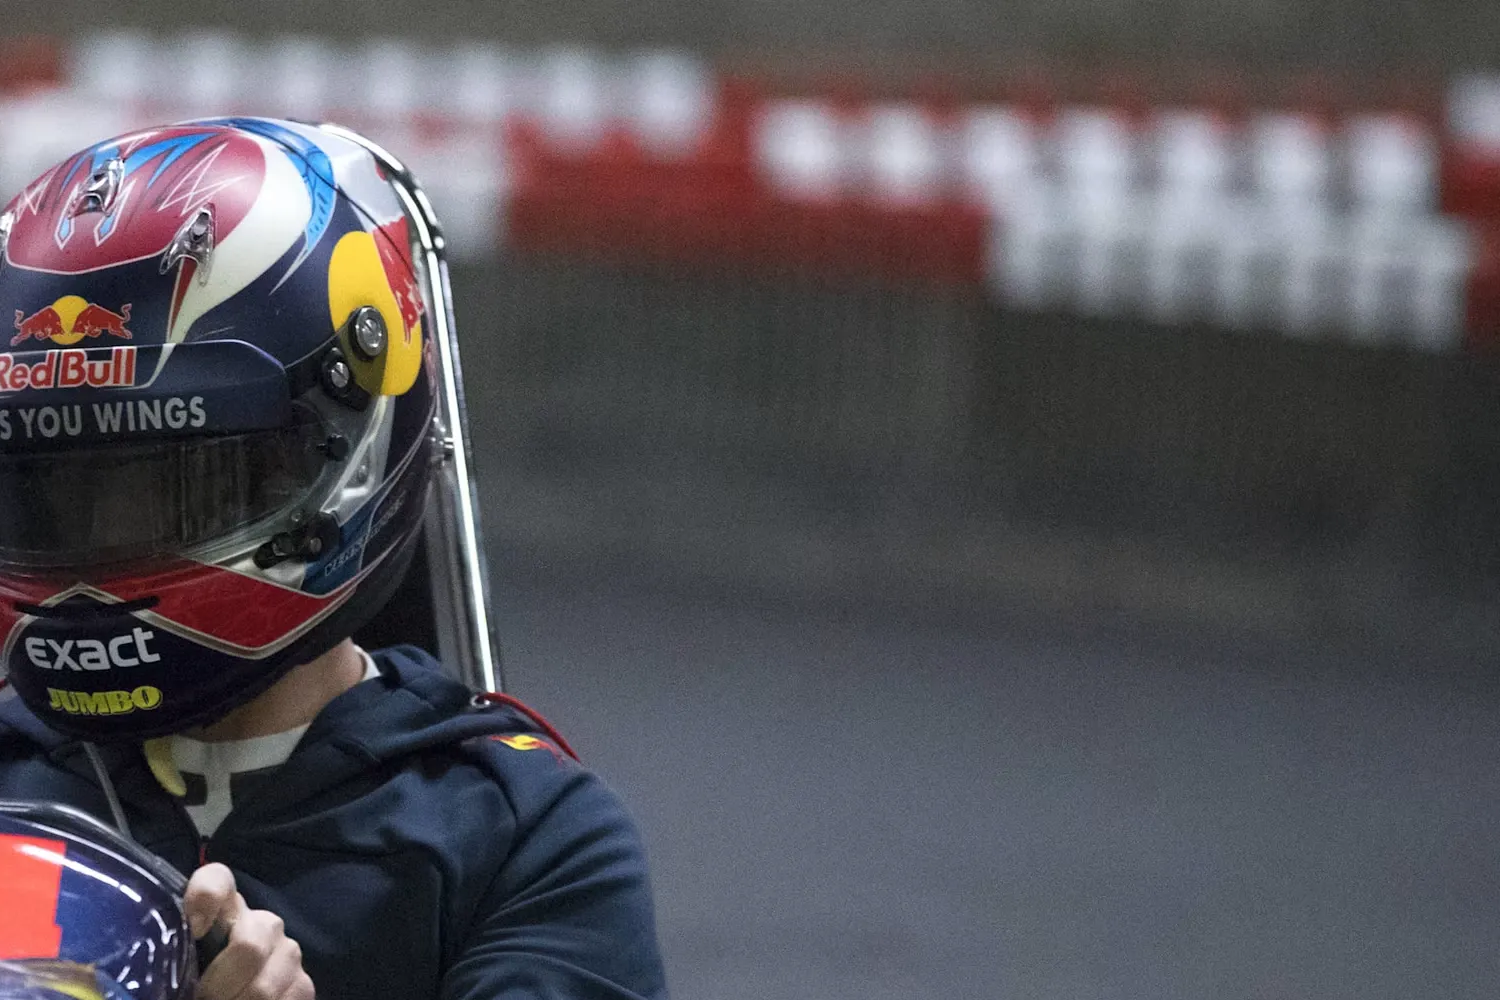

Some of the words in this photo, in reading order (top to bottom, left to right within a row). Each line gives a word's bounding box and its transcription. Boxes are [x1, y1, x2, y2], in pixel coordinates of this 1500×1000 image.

[58, 346, 137, 387] Bull
[19, 404, 83, 439] YOU
[93, 396, 206, 433] WINGS
[26, 627, 160, 671] exact
[46, 684, 163, 716] JUMBO
